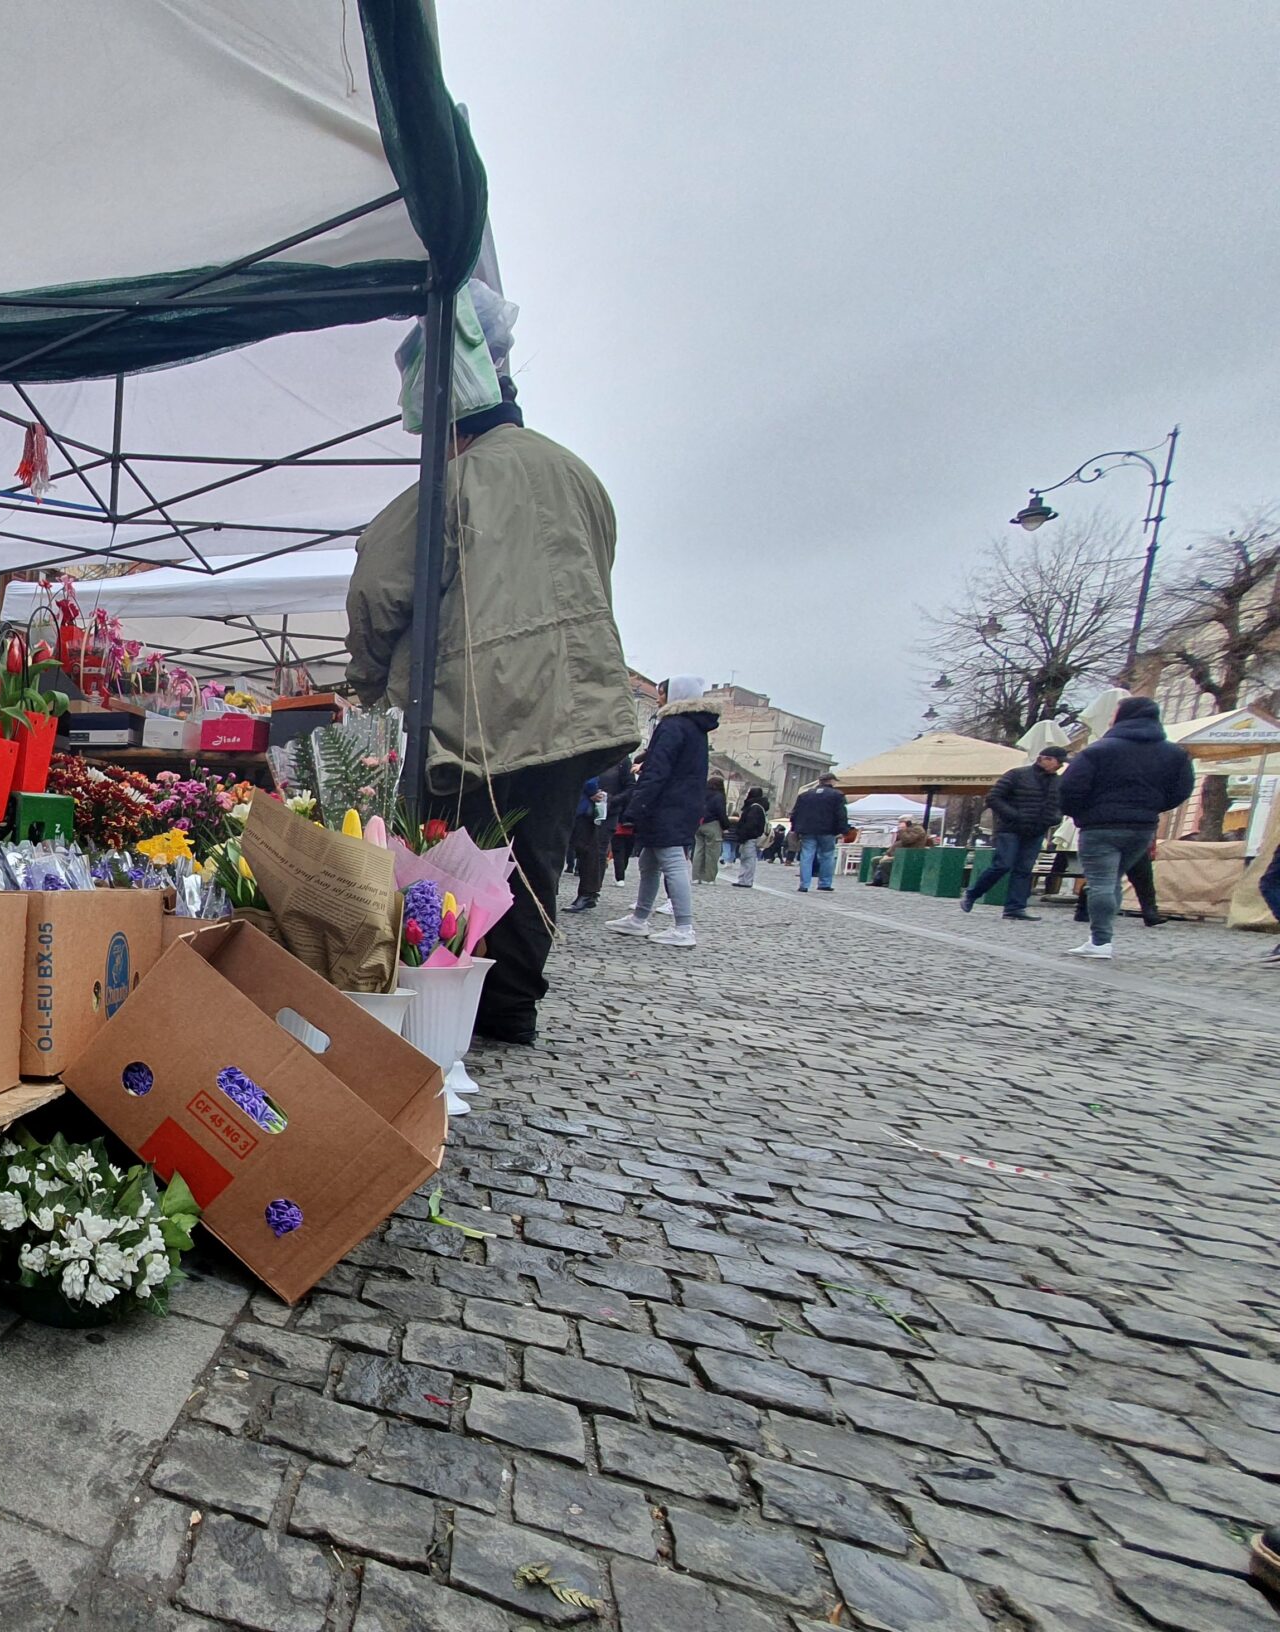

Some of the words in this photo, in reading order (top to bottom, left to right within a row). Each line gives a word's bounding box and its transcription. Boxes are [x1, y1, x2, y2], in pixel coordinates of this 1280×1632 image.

[321, 869, 336, 879] one
[337, 876, 357, 888] than
[333, 886, 347, 897] for
[345, 892, 372, 905] travels
[37, 922, 53, 978] BX-05
[37, 985, 53, 1051] O-L-EU
[195, 1100, 212, 1114] CF
[210, 1114, 225, 1128] 45
[222, 1125, 241, 1143] NG
[239, 1140, 249, 1151] 3
